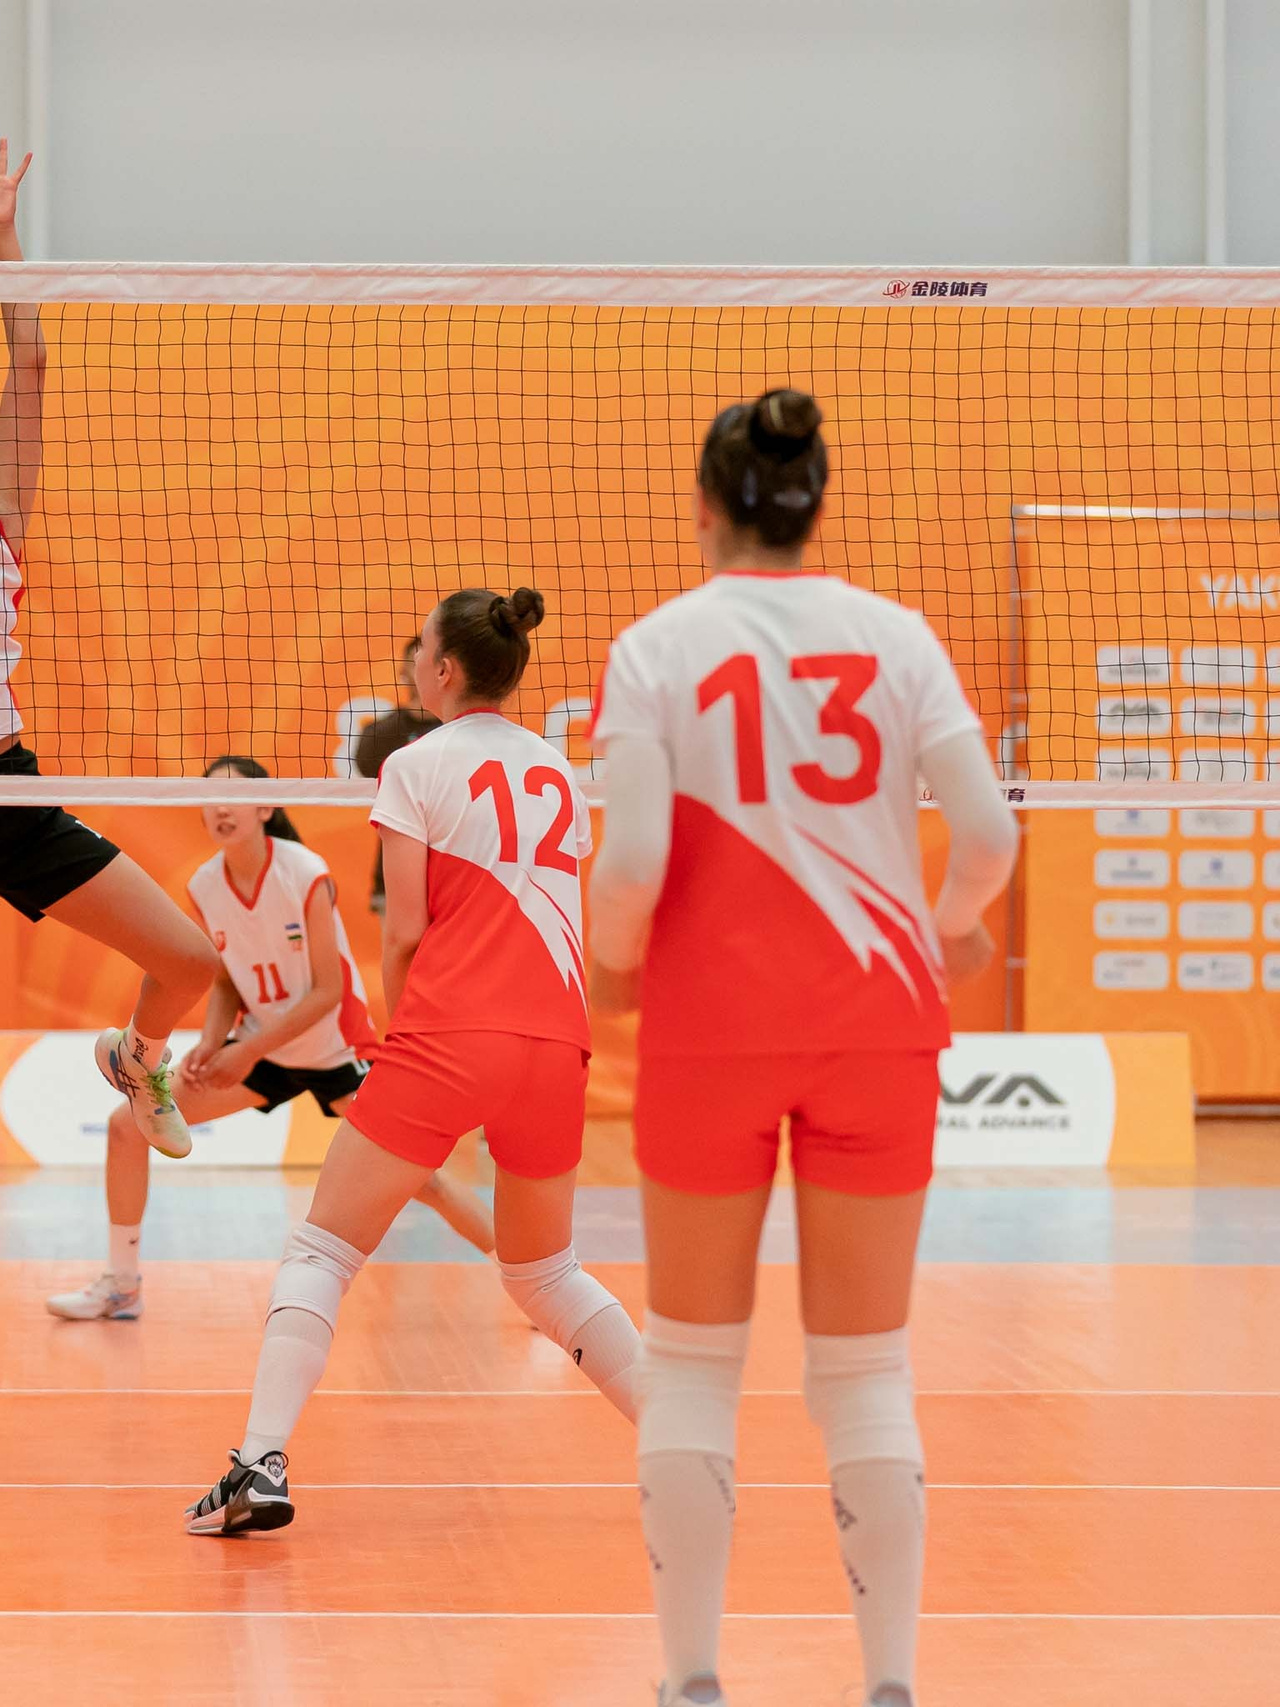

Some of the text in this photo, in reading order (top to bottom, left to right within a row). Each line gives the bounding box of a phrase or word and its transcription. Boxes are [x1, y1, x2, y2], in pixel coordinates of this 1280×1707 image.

[911, 281, 988, 297] 金陵体育
[1200, 573, 1280, 610] YAK
[696, 653, 883, 806] 13
[467, 759, 578, 878] 12
[252, 962, 290, 1004] 11
[940, 1074, 1067, 1105] VA
